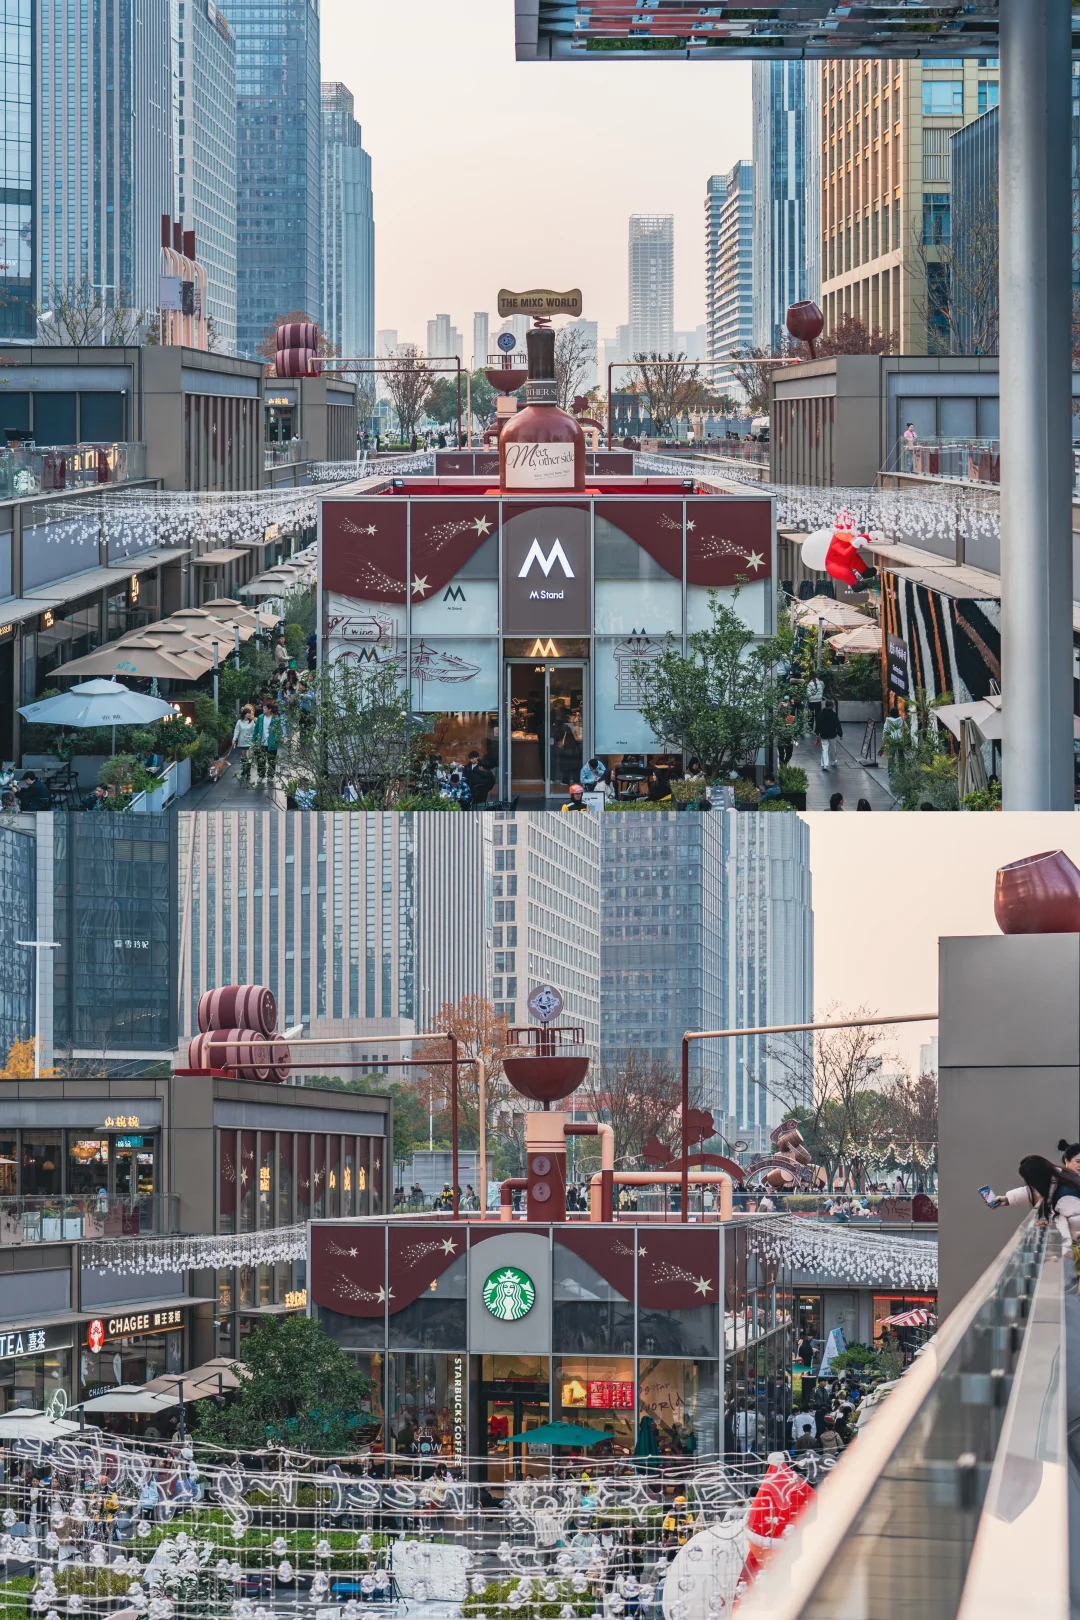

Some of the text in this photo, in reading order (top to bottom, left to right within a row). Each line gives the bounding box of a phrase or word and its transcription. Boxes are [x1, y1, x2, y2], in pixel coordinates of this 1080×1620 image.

[501, 297, 578, 308] THE MIXC WORLD
[517, 537, 576, 578] M
[529, 590, 565, 600] M Stand
[108, 1314, 150, 1335] CHAGEE
[0, 1330, 46, 1357] TEA 喜茶
[454, 1357, 463, 1467] STARBUCKS COFFEE
